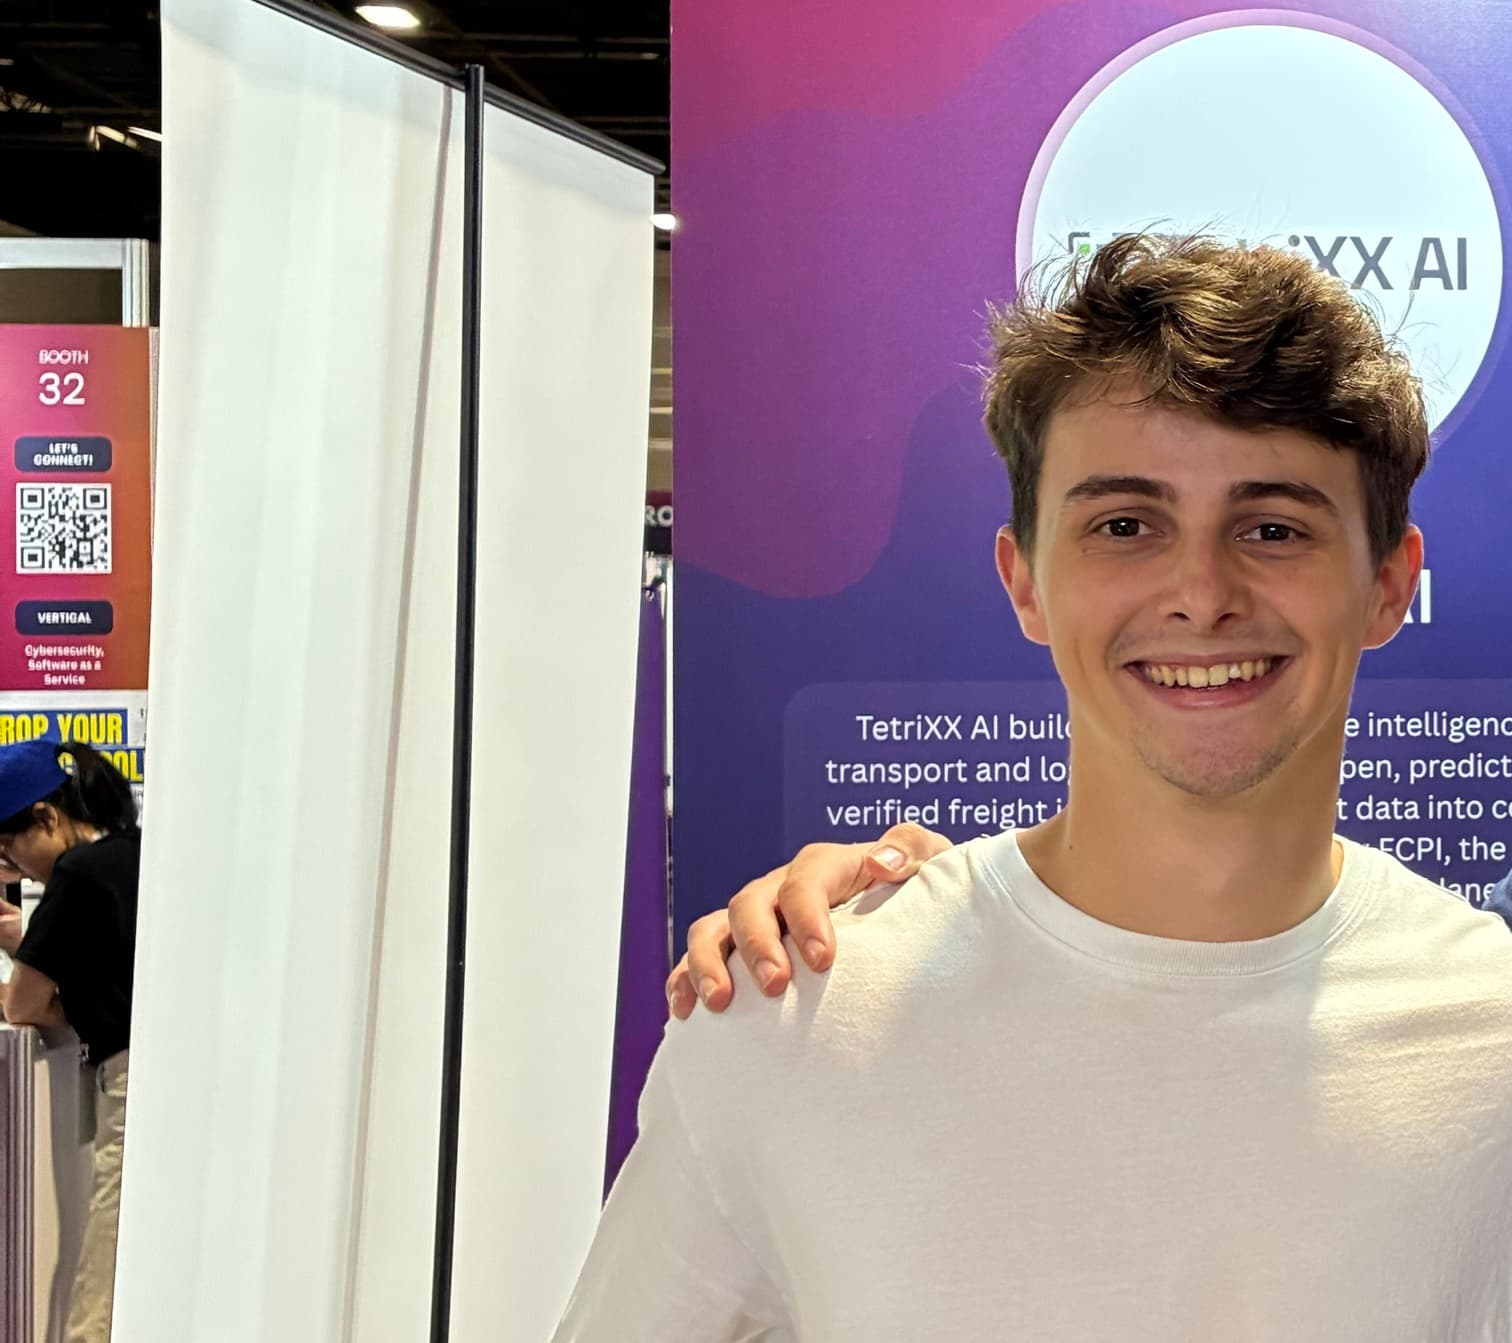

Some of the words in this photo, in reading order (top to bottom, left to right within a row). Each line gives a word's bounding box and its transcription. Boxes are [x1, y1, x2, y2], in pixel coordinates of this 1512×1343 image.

[1409, 237, 1467, 290] AI
[39, 350, 88, 365] BOOTH
[39, 372, 85, 405] 32
[37, 611, 92, 624] VERTICAL
[44, 673, 85, 685] Service
[57, 713, 122, 744] YOUR
[856, 715, 962, 741] TetriXX
[971, 716, 998, 740] AI
[825, 759, 967, 788] transport
[976, 755, 1030, 782] and
[1041, 755, 1071, 786] lo
[826, 798, 939, 826] verified
[949, 797, 1047, 829] freight
[1356, 794, 1420, 820] data
[1428, 795, 1482, 820] into
[1459, 835, 1506, 861] the
